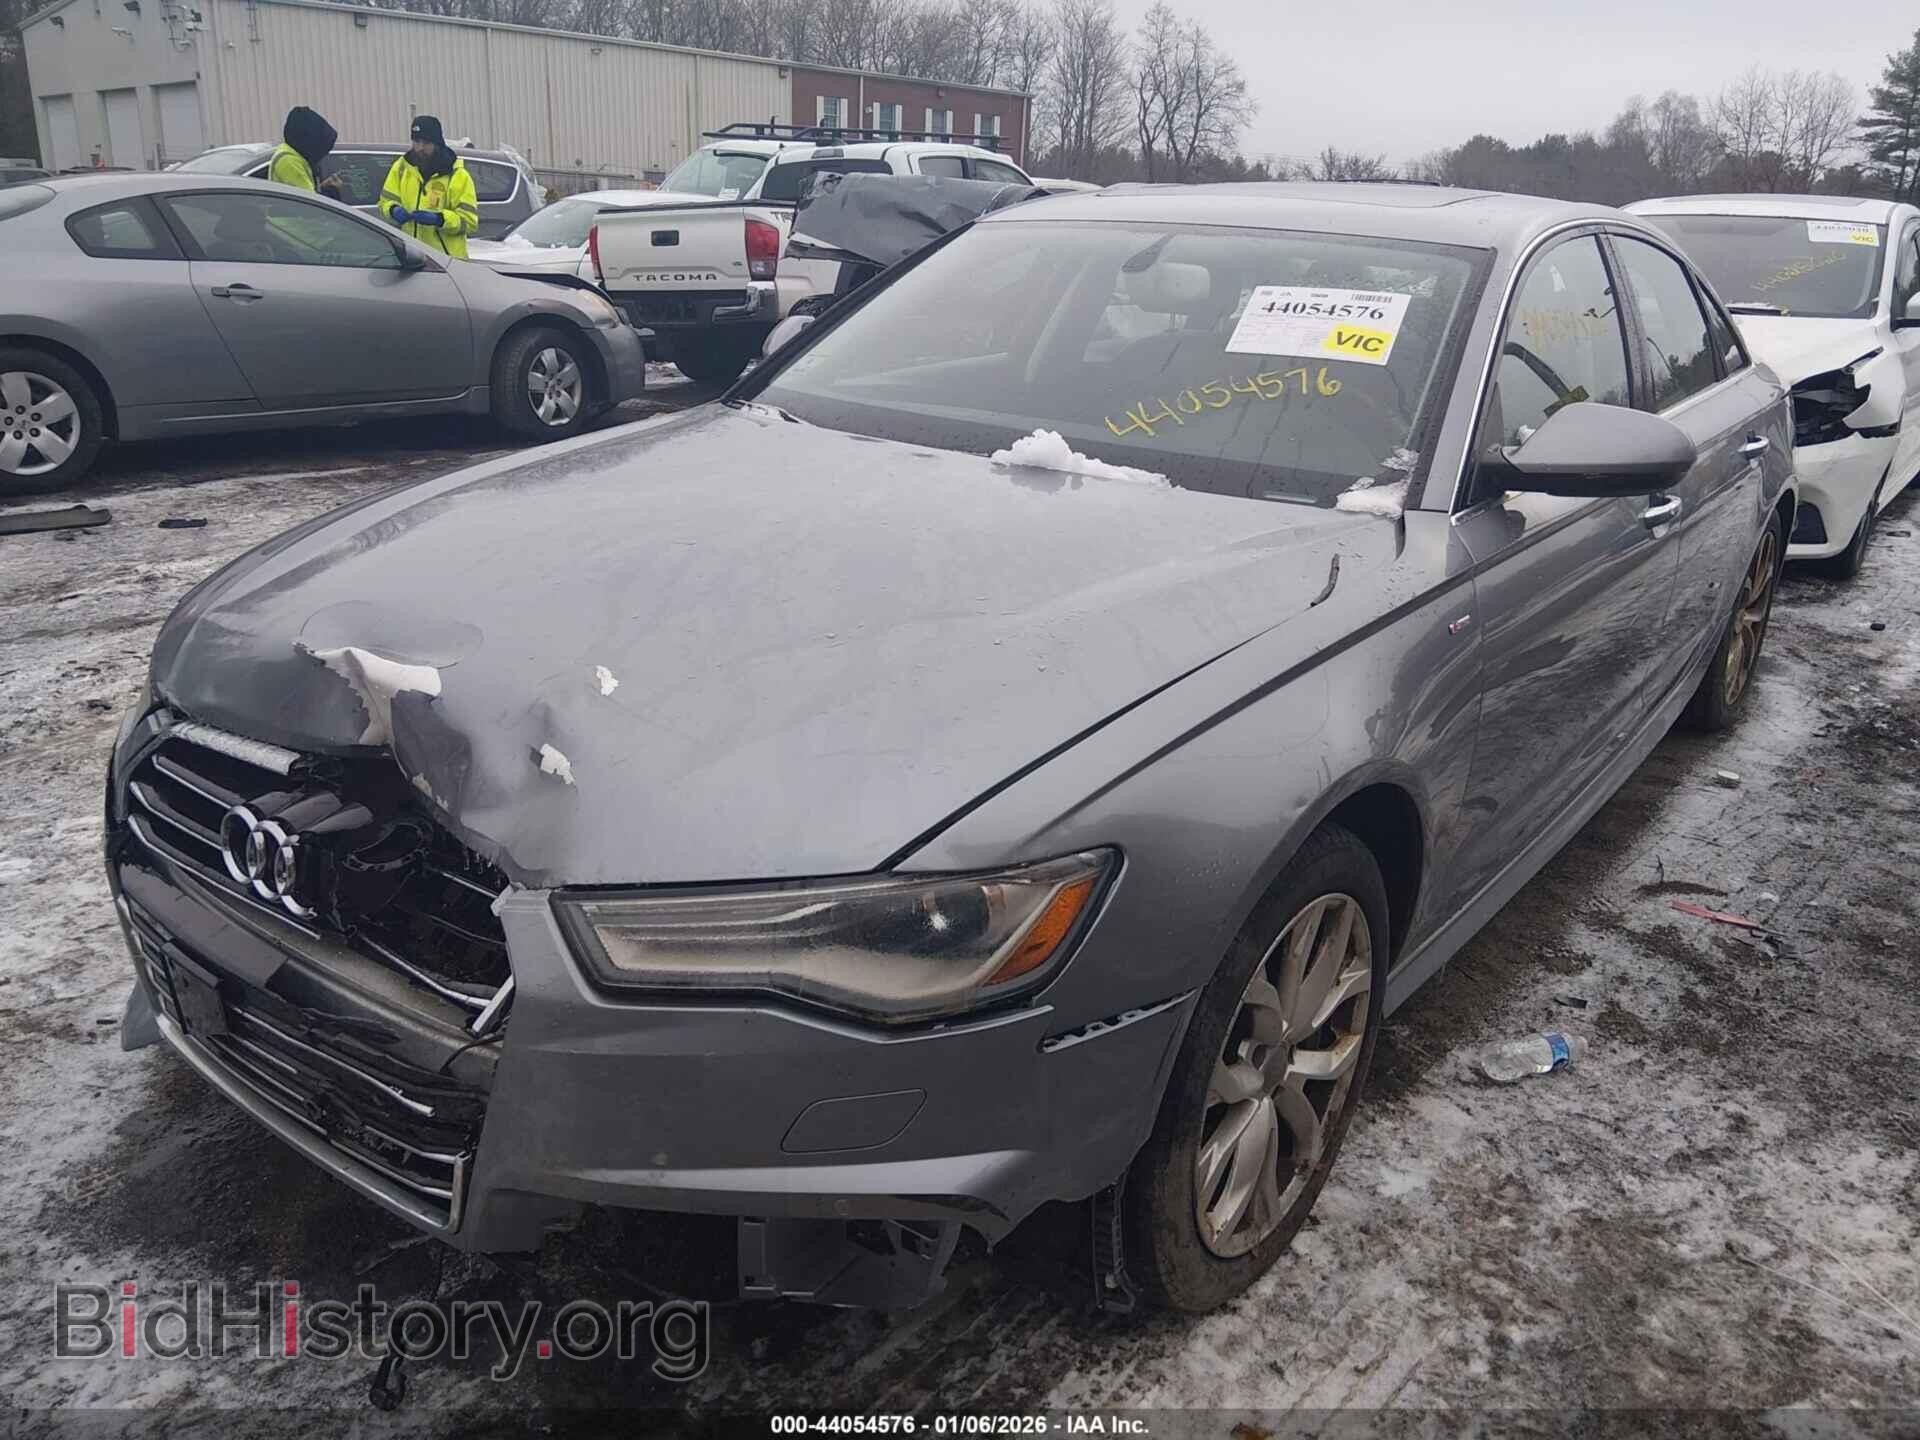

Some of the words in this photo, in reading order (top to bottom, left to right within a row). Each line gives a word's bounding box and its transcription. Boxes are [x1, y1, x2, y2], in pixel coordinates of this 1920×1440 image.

[633, 273, 717, 282] TACOMA
[1261, 301, 1384, 320] 44054576
[1336, 331, 1384, 352] VIC
[1104, 367, 1343, 437] 44054576
